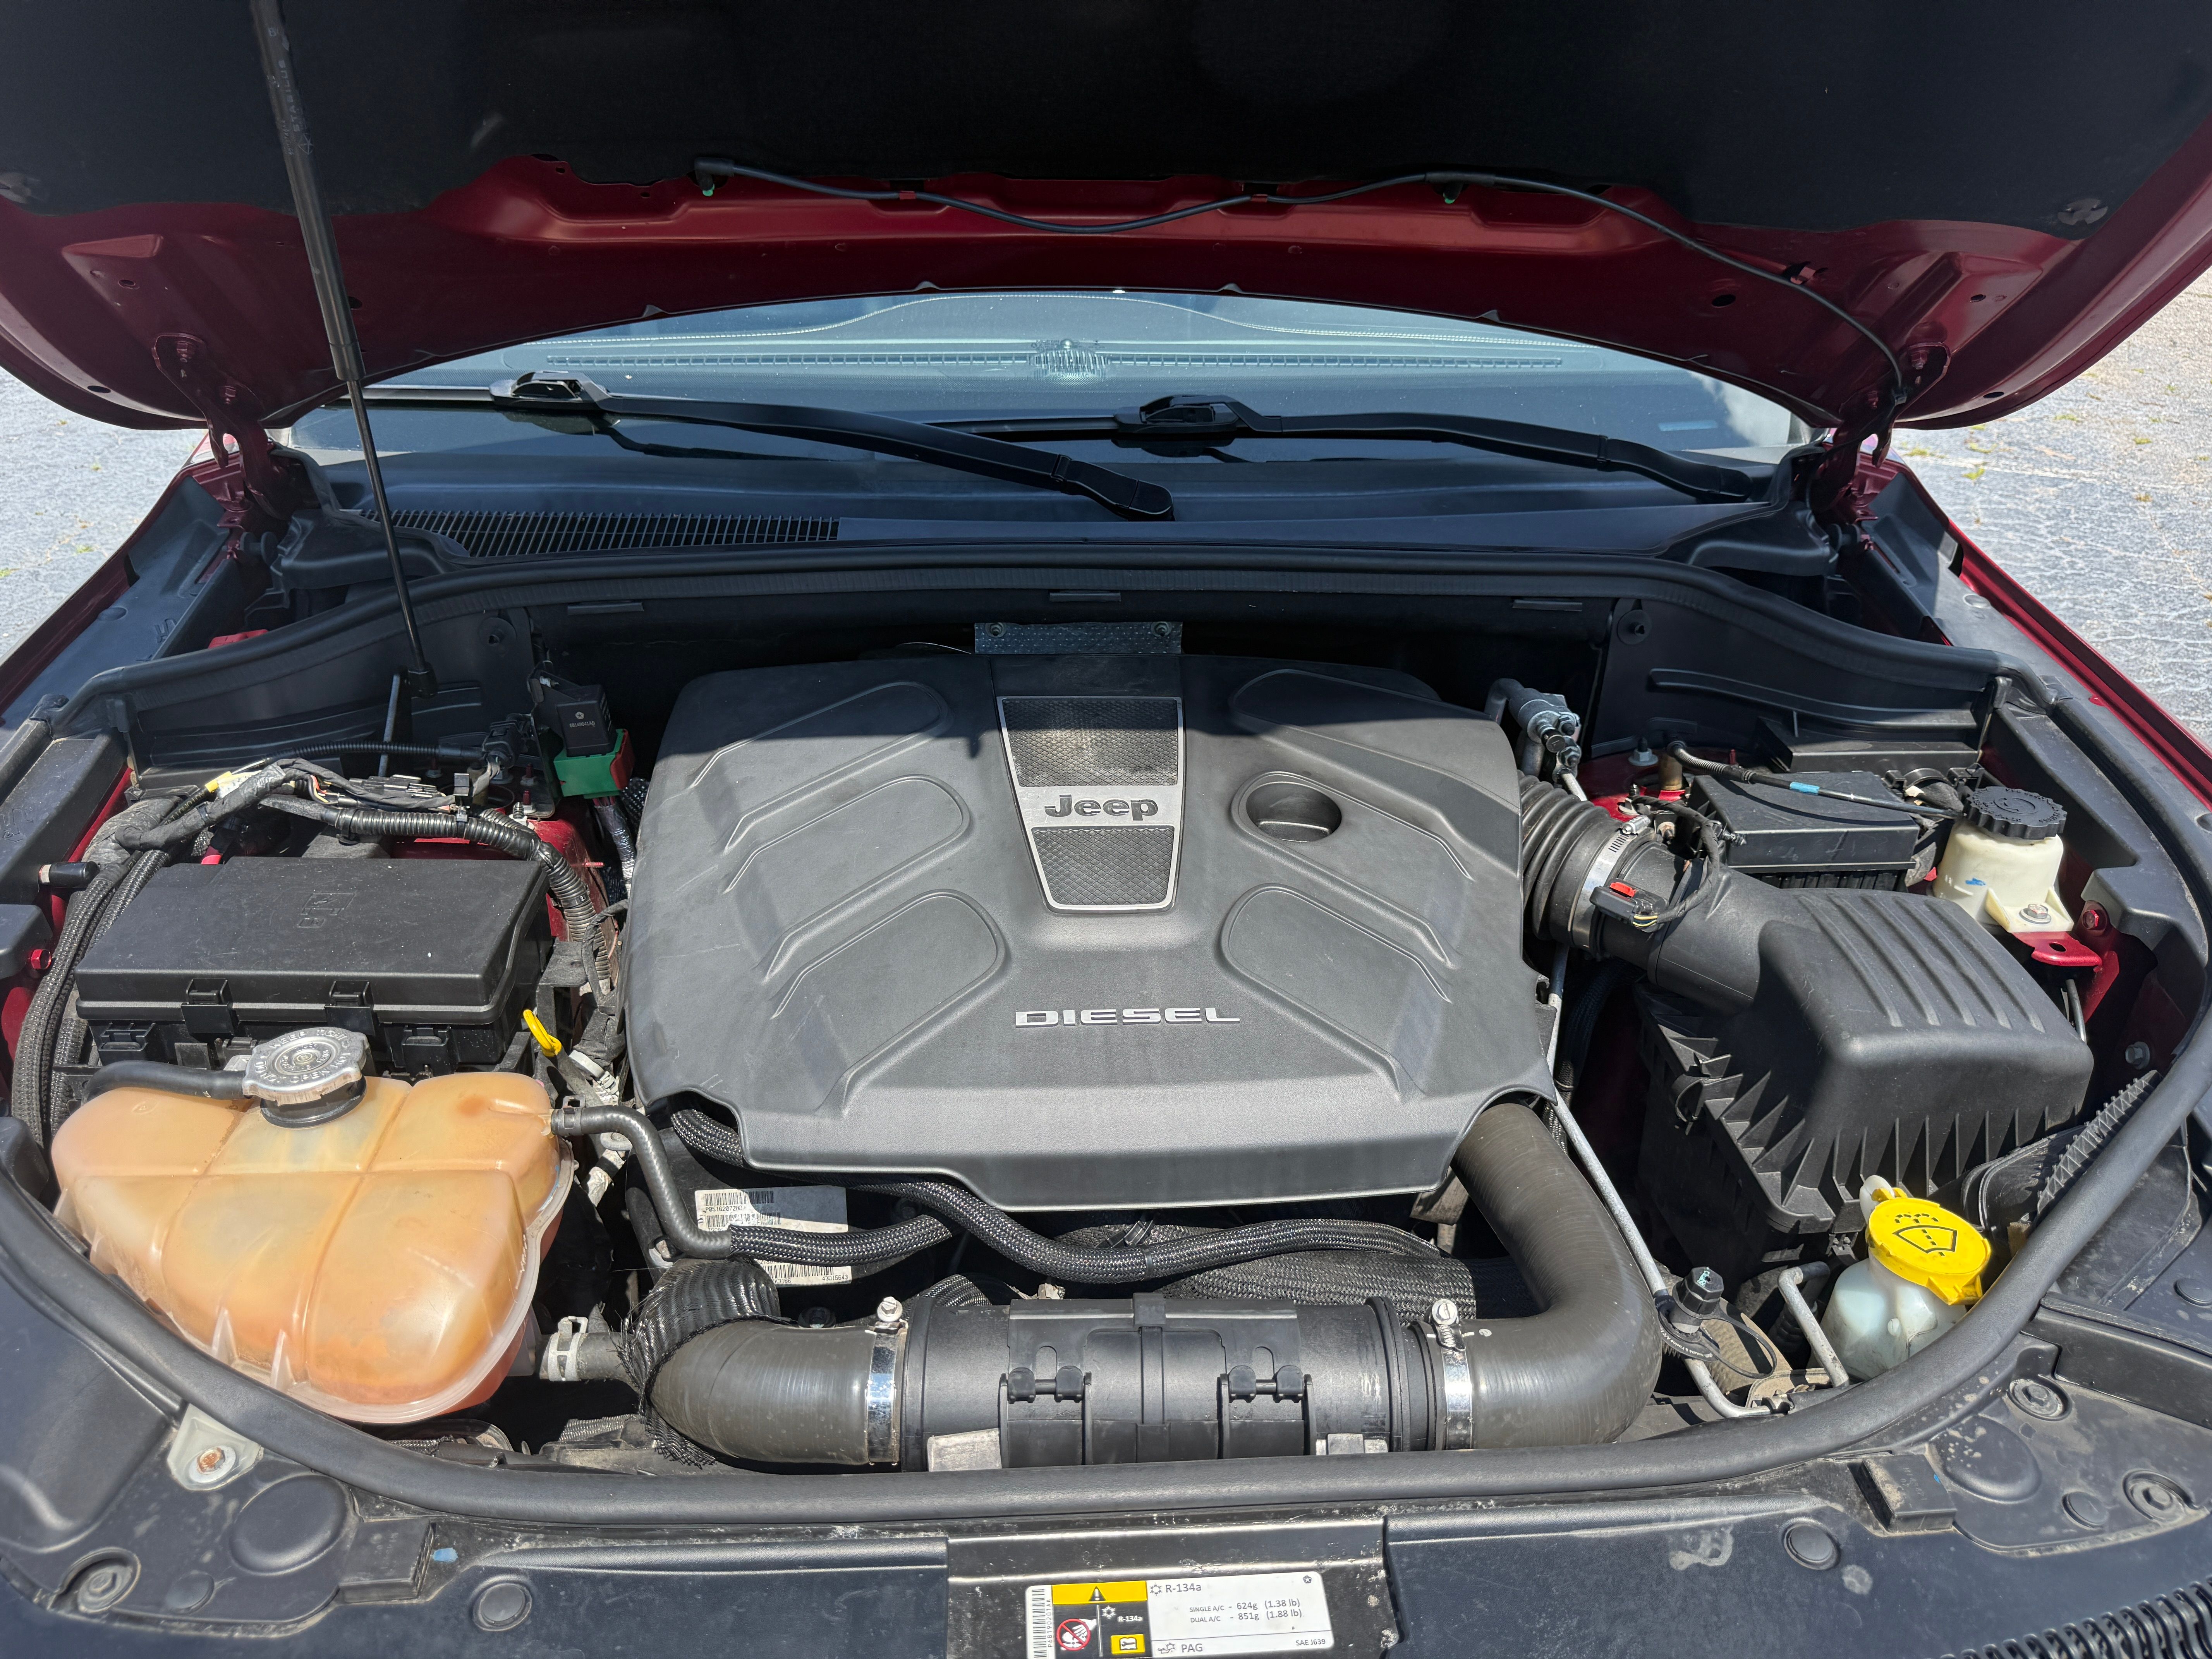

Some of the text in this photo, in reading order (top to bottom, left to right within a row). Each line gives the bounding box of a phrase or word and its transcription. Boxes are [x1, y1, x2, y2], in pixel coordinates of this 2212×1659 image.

[278, 58, 300, 132] STABILUS
[1044, 794, 1158, 821] Jeep
[1015, 1007, 1240, 1027] DIESEL
[270, 1030, 307, 1049] KEEP
[289, 1067, 331, 1083] OPEN
[1165, 1583, 1202, 1593] R-134a
[1237, 1602, 1258, 1611] 624g
[1264, 1599, 1286, 1609] (1.38
[1288, 1598, 1300, 1607] lb)
[1238, 1612, 1260, 1621] 851g
[1266, 1610, 1288, 1620] (1.88
[1290, 1609, 1302, 1618] lb)
[1181, 1643, 1204, 1653] PAG
